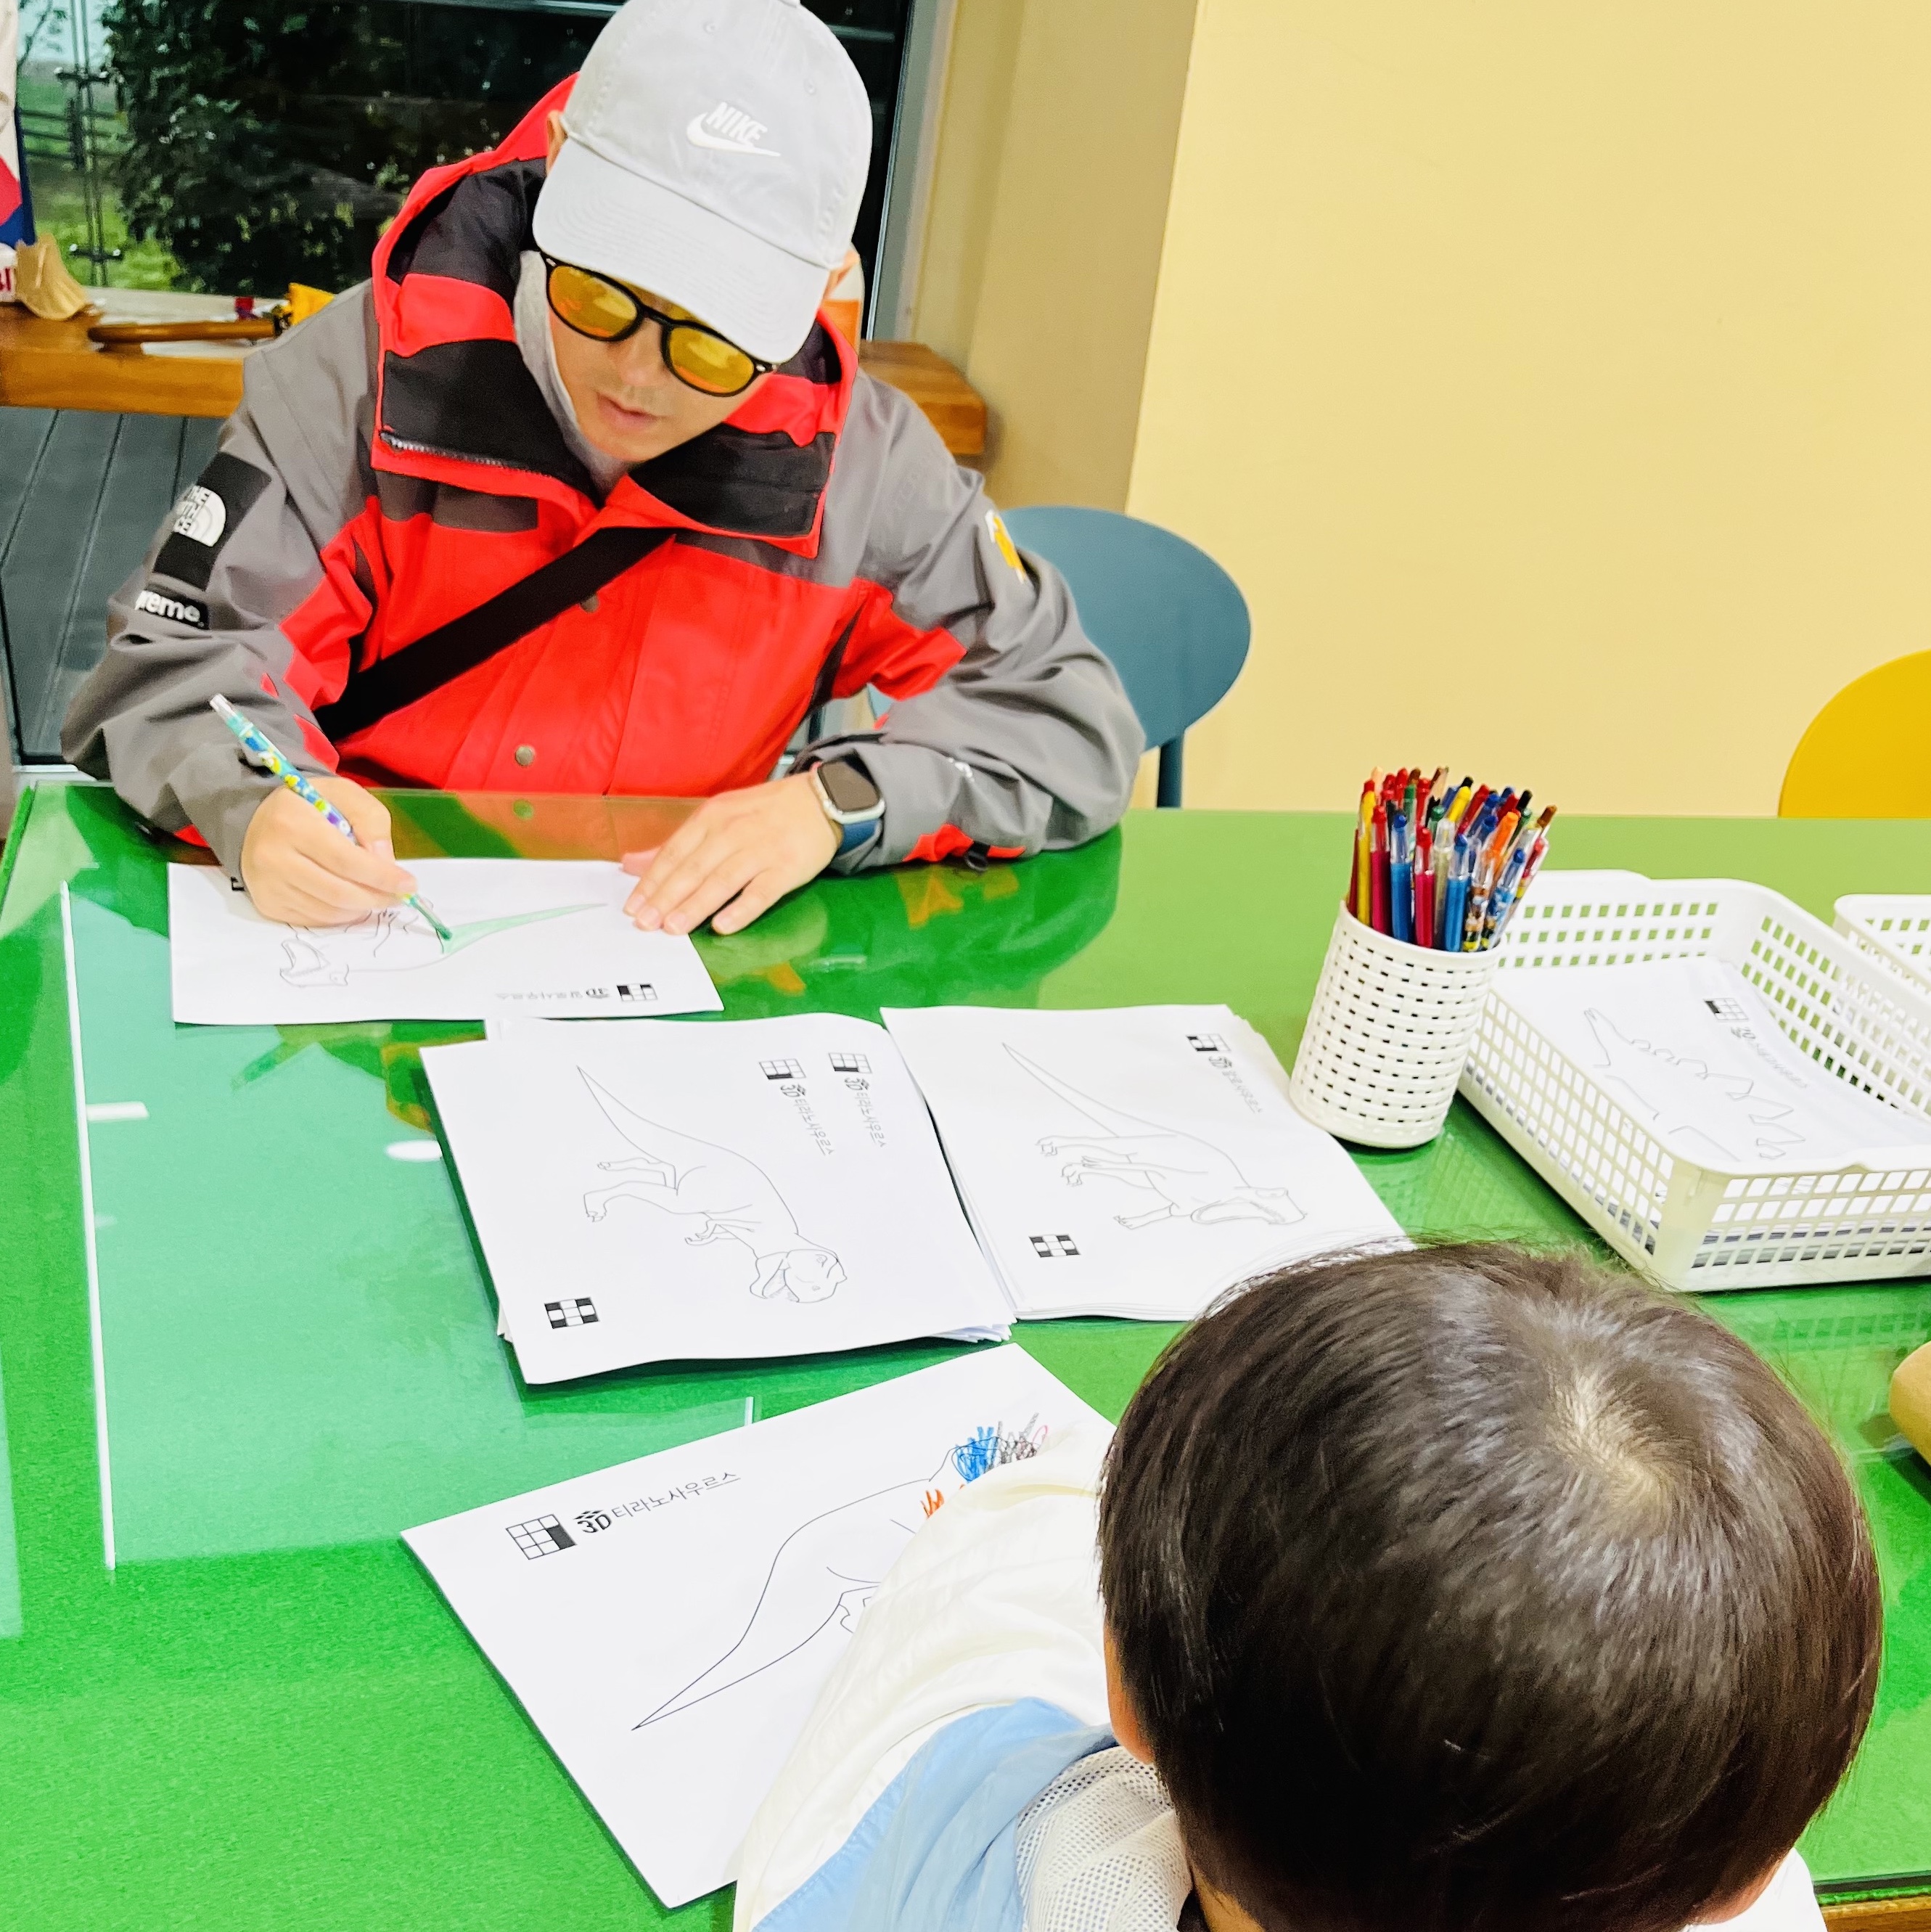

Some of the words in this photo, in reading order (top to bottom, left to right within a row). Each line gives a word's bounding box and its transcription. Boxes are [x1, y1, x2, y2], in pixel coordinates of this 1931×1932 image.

[706, 102, 768, 147] NIKE
[780, 1084, 800, 1097] 3D
[794, 1098, 834, 1155] 티라노사우르스
[845, 1077, 863, 1090] 3D
[855, 1092, 886, 1147] 티라노사우르스
[577, 1513, 612, 1534] 3D
[611, 1472, 741, 1518] 티라노사우르스
